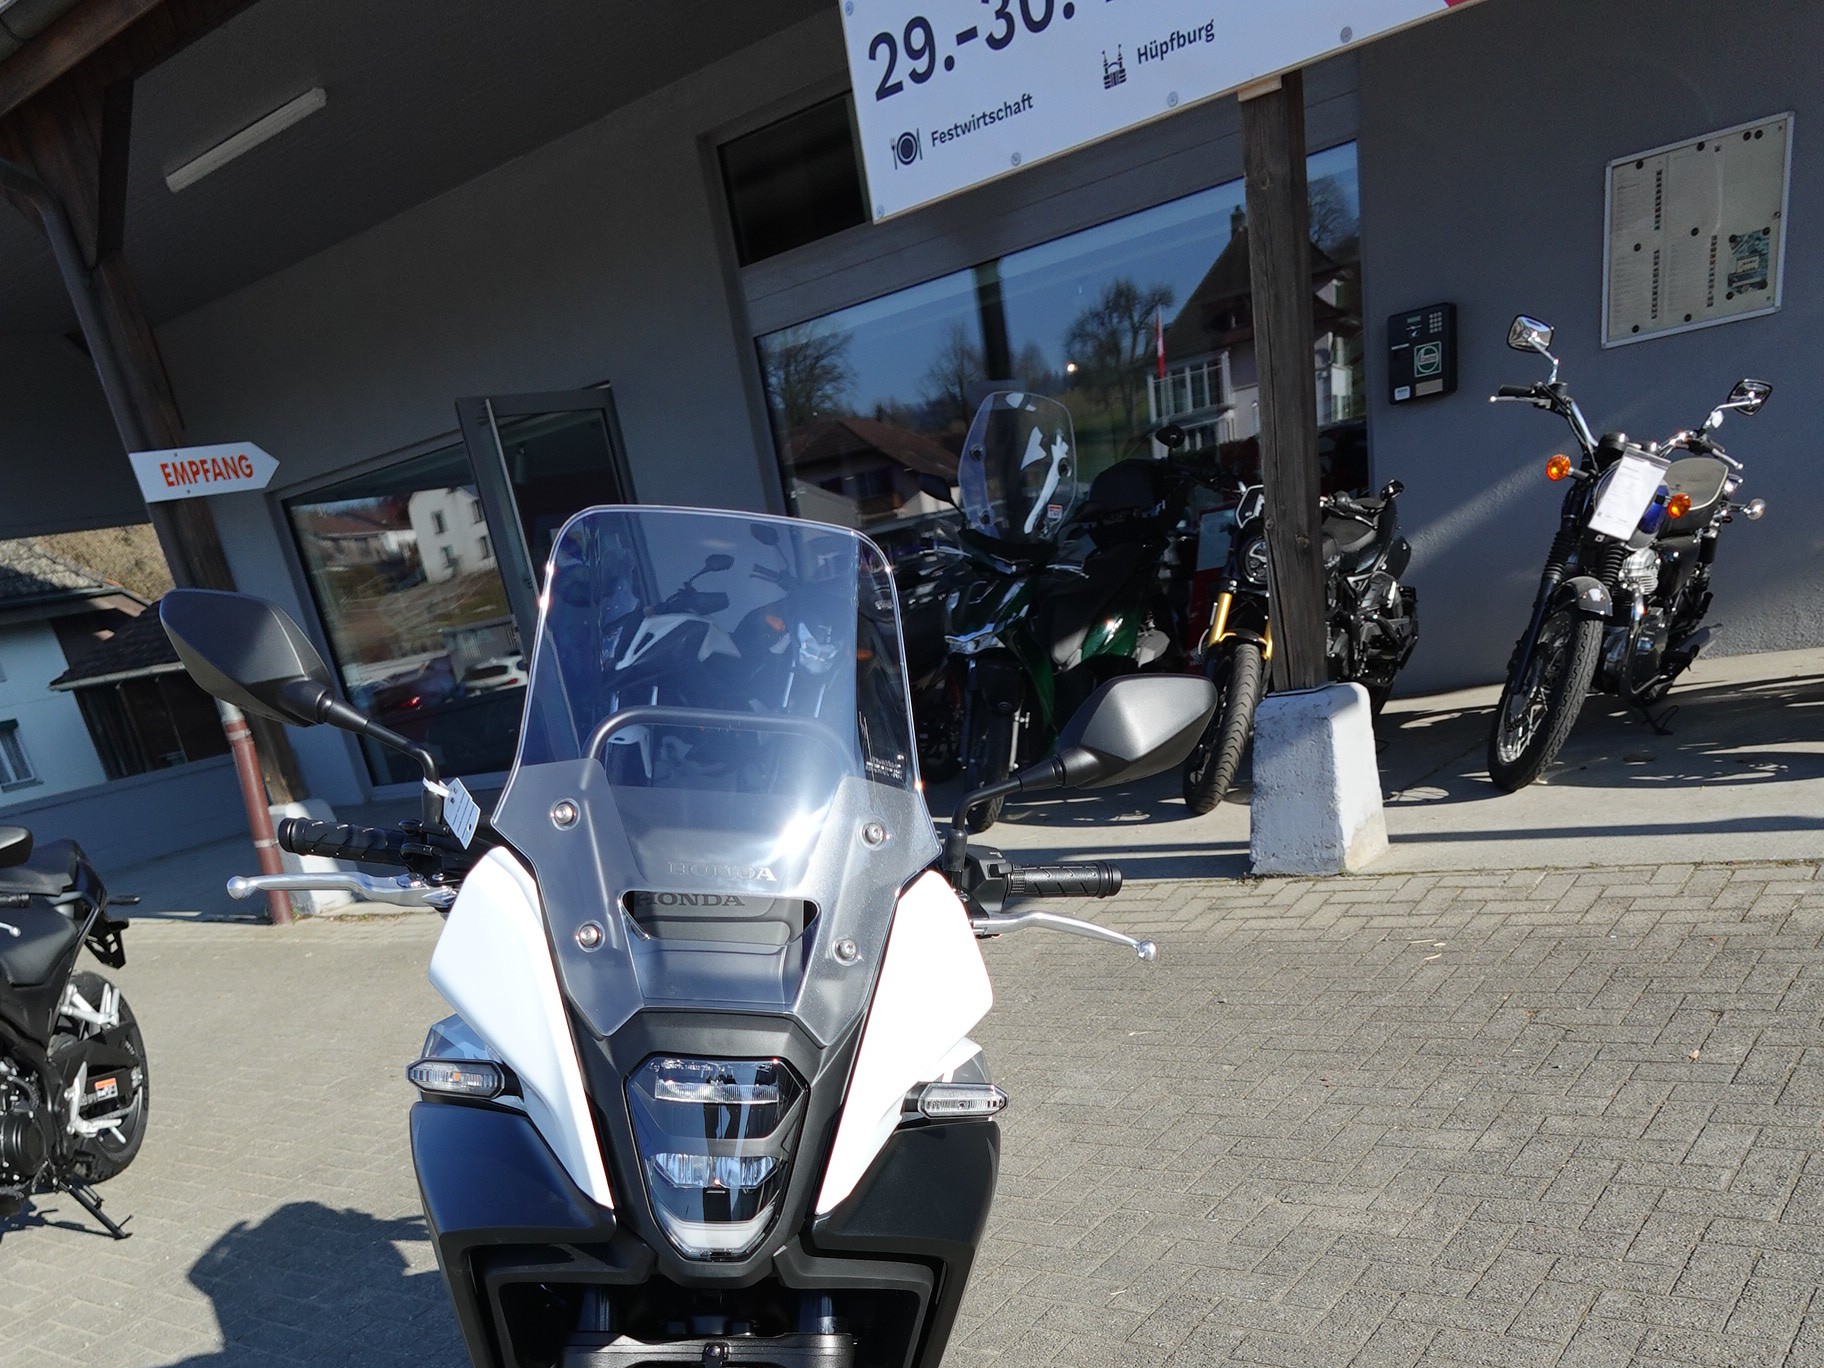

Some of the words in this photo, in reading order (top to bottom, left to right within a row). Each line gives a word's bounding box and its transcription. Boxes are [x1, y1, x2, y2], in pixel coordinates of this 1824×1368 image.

[1136, 19, 1215, 64] Hüpfburg
[930, 93, 1034, 147] Festwirtschaft
[160, 454, 253, 487] EMPFANG
